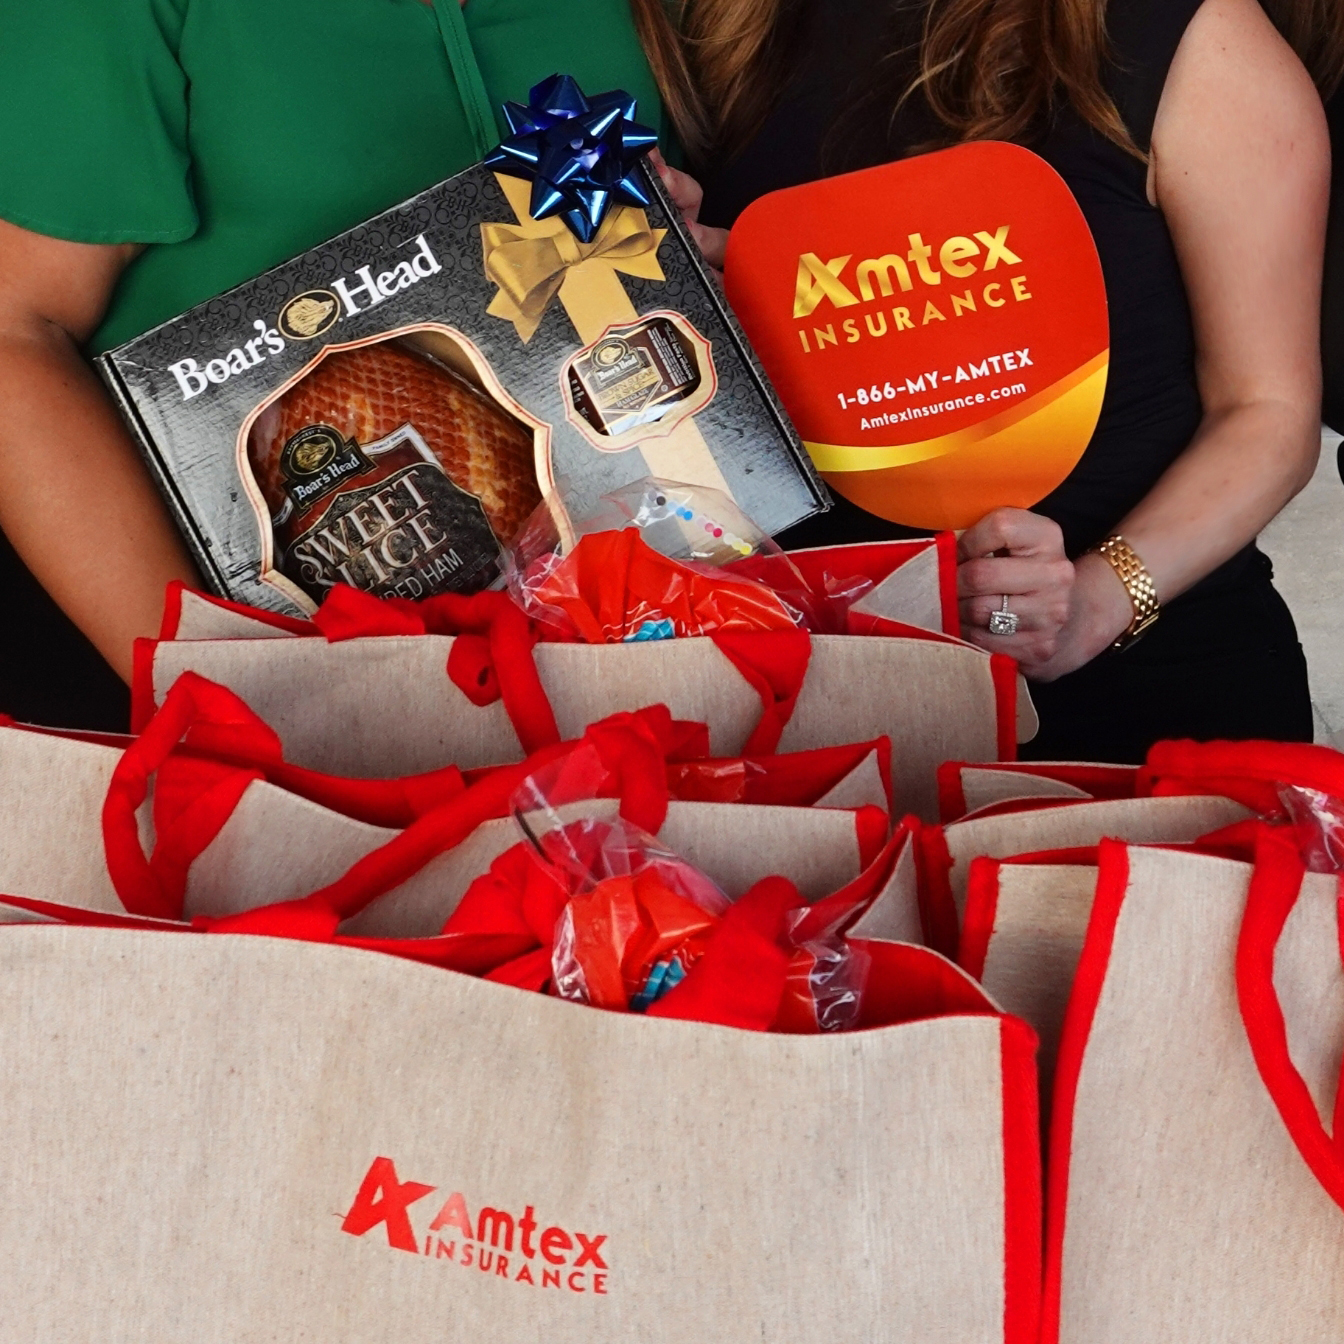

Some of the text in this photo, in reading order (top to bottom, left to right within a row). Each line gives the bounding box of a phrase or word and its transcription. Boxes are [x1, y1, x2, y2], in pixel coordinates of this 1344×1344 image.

[792, 224, 1024, 320] Amtex
[166, 233, 444, 403] Boar's Head
[798, 275, 1034, 354] INSURANCE
[837, 347, 1035, 411] 1-866-MY-AMTEX
[859, 381, 1027, 431] AmtexInsurance.com
[293, 453, 361, 501] Boar's Head
[294, 469, 430, 571] SWEET
[422, 548, 465, 586] HAM
[425, 1234, 609, 1295] INSURANCE
[428, 1191, 610, 1270] Amtex
